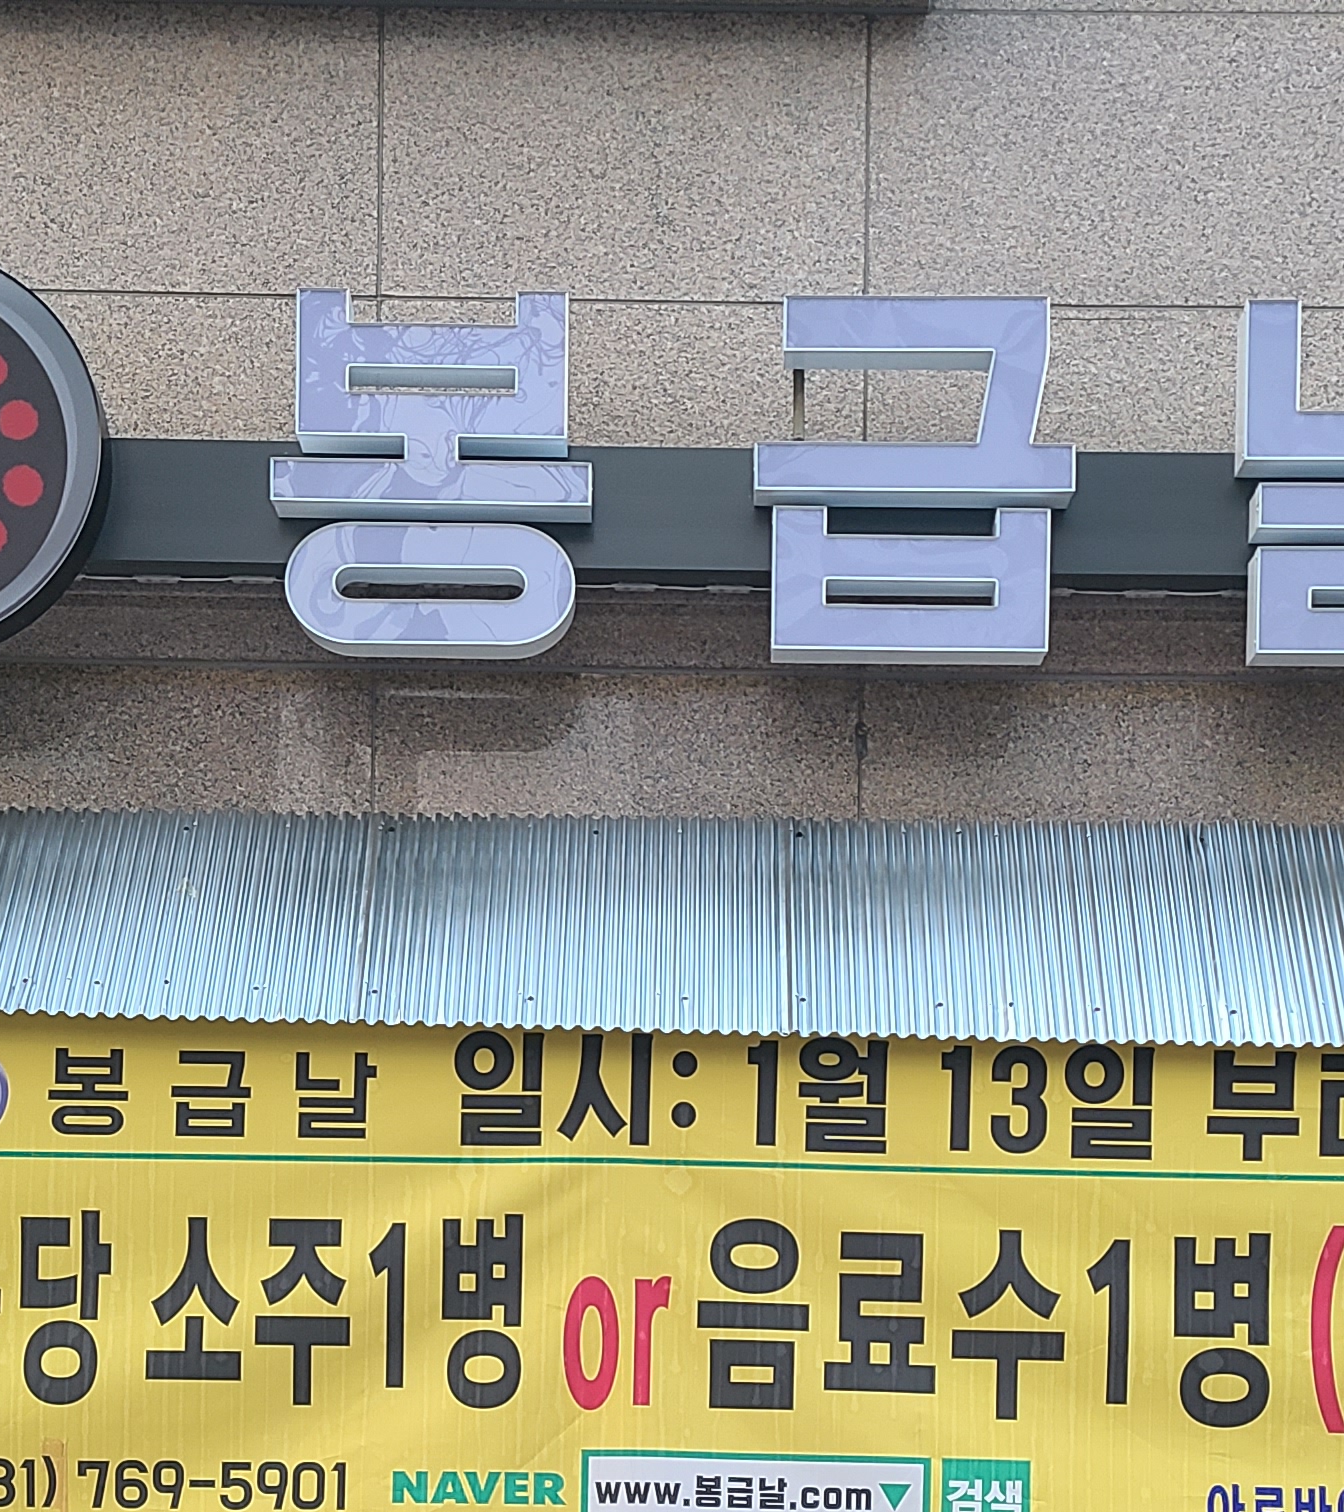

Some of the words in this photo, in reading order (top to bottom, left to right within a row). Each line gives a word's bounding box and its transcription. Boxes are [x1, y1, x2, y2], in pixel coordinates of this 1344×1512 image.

[47, 1047, 376, 1140] 봉급날
[454, 1030, 698, 1147] 일시:
[747, 1036, 889, 1154] 1월
[941, 1044, 1155, 1161] 13일
[145, 1212, 525, 1410] 소주1병
[562, 1275, 671, 1411] or
[696, 1218, 1272, 1429] 음료수1병
[77, 1460, 348, 1511] 769-5901
[392, 1469, 566, 1507] NAVER
[594, 1473, 873, 1512] www.봉급날.com
